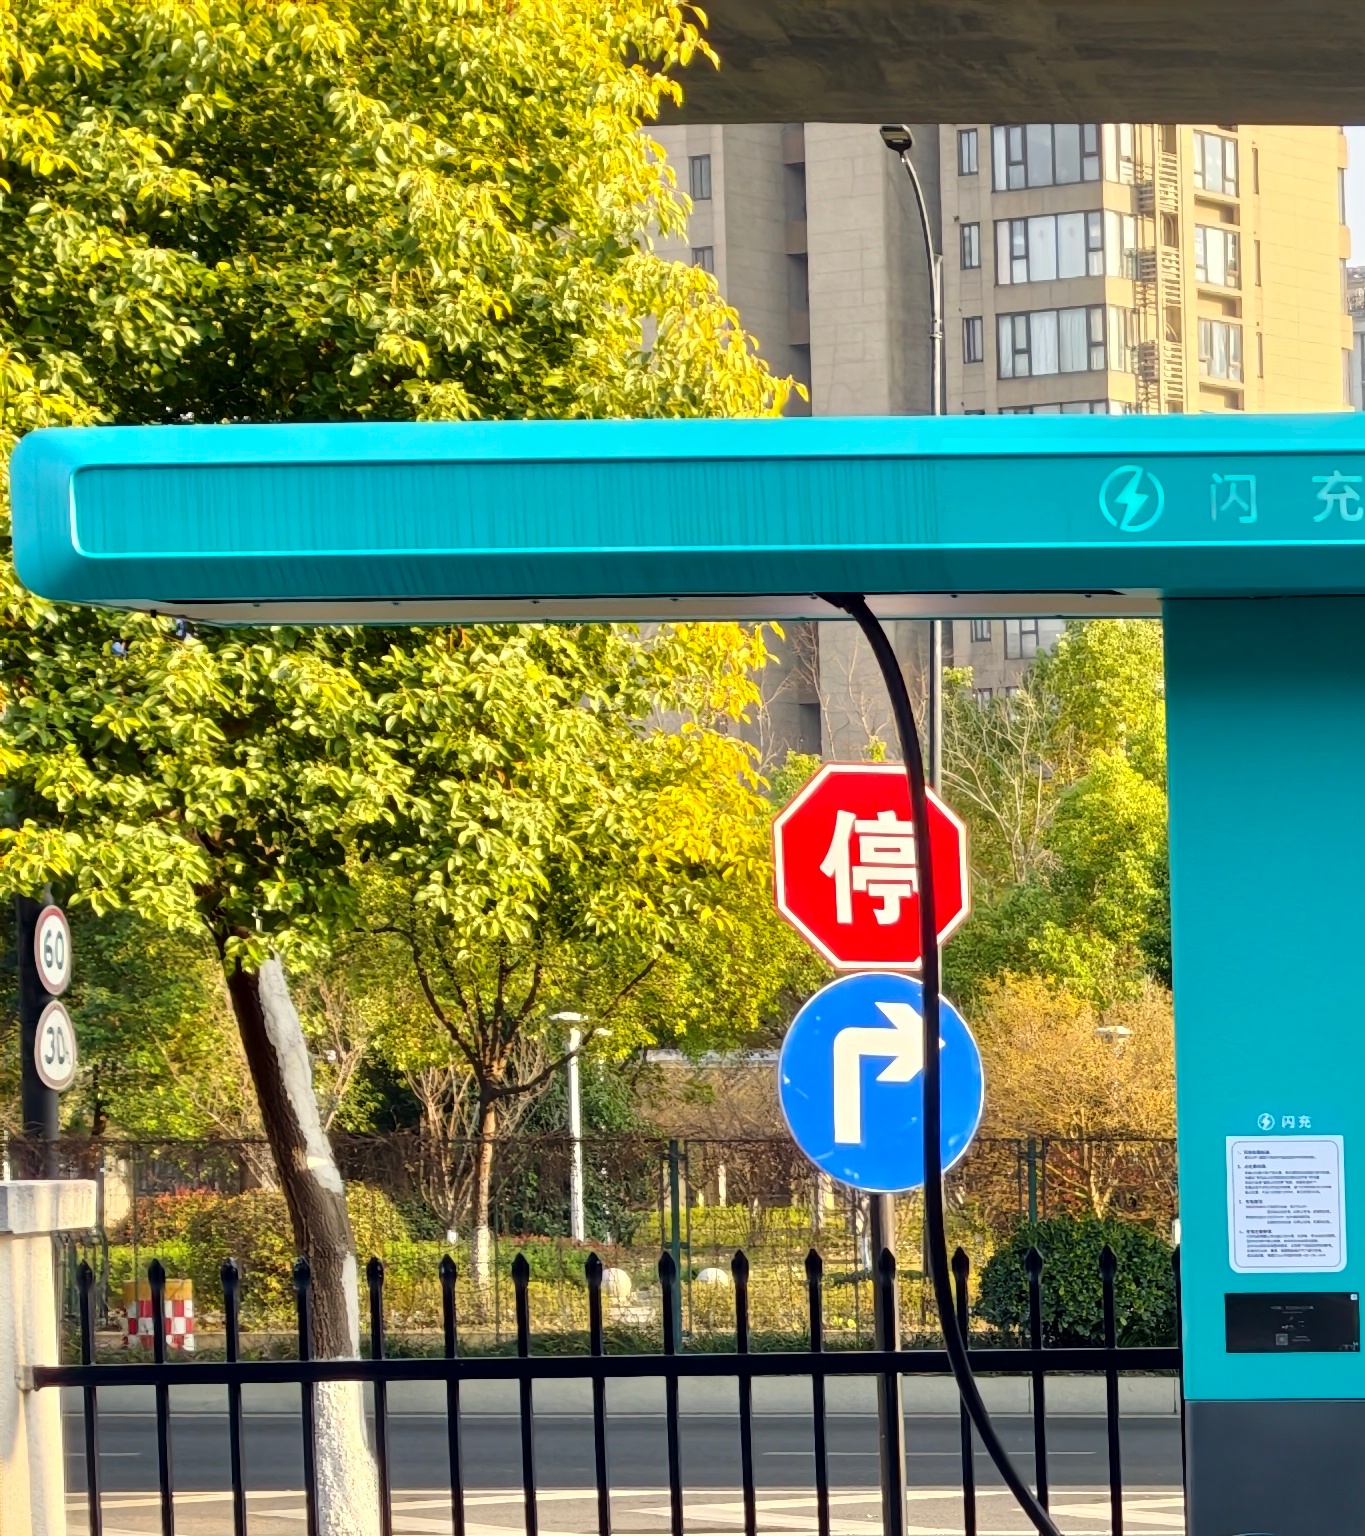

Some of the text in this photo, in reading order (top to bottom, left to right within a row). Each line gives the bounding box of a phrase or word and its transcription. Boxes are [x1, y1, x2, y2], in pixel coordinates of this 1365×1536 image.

[1210, 470, 1364, 524] 闪充
[820, 810, 919, 925] 停
[43, 929, 65, 970] 60
[1281, 1115, 1312, 1129] 闪充
